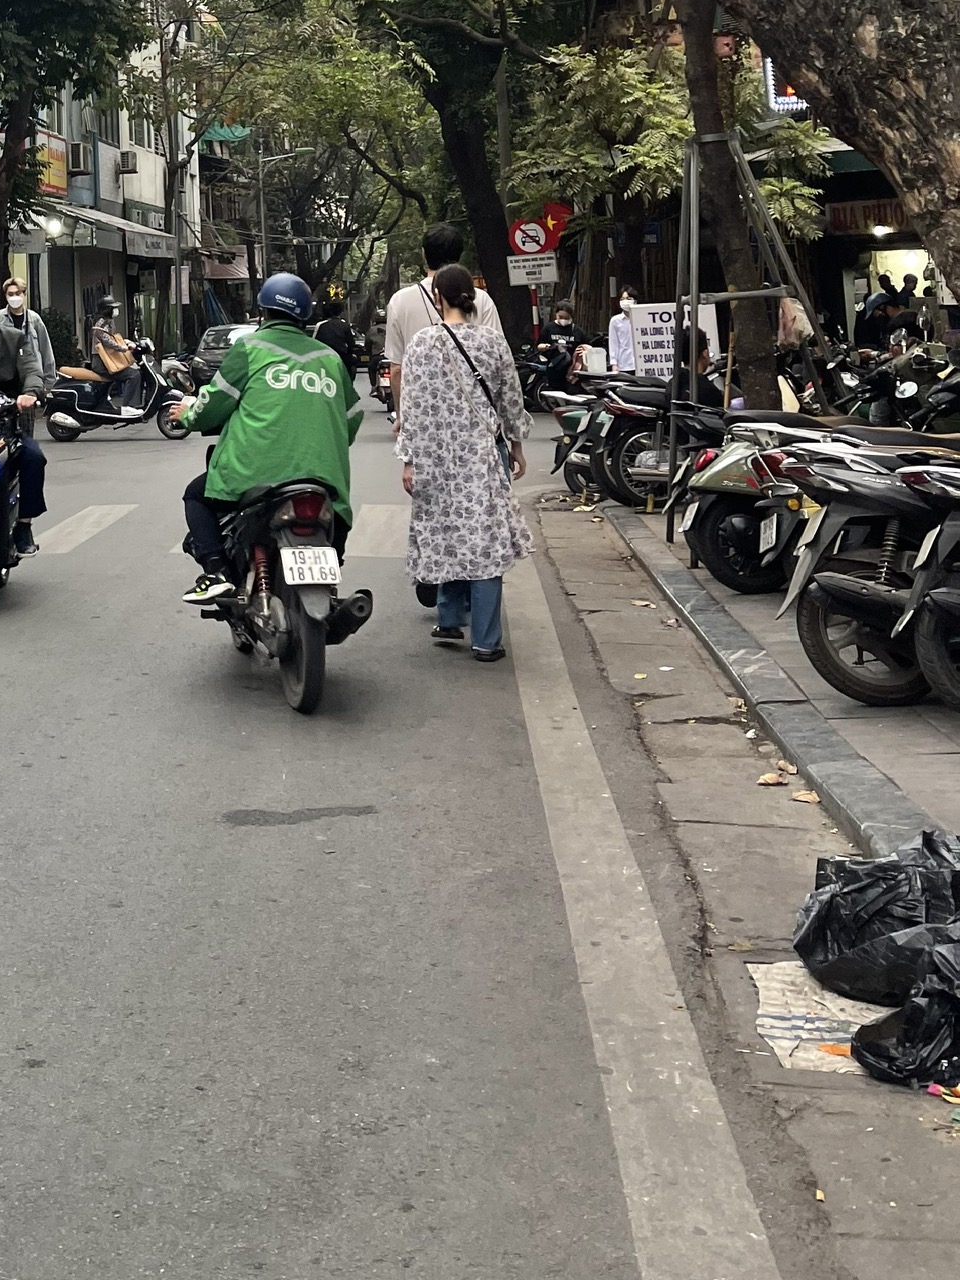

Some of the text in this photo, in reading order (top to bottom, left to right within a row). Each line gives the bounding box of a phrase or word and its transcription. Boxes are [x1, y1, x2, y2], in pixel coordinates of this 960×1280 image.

[640, 327, 649, 336] HA
[650, 326, 664, 336] LONG
[642, 340, 671, 350] HA LONG 2
[643, 354, 658, 363] SAPA
[660, 354, 664, 363] 2
[265, 363, 337, 398] Grab
[292, 550, 328, 565] 19-H1
[289, 566, 337, 581] 181.69
